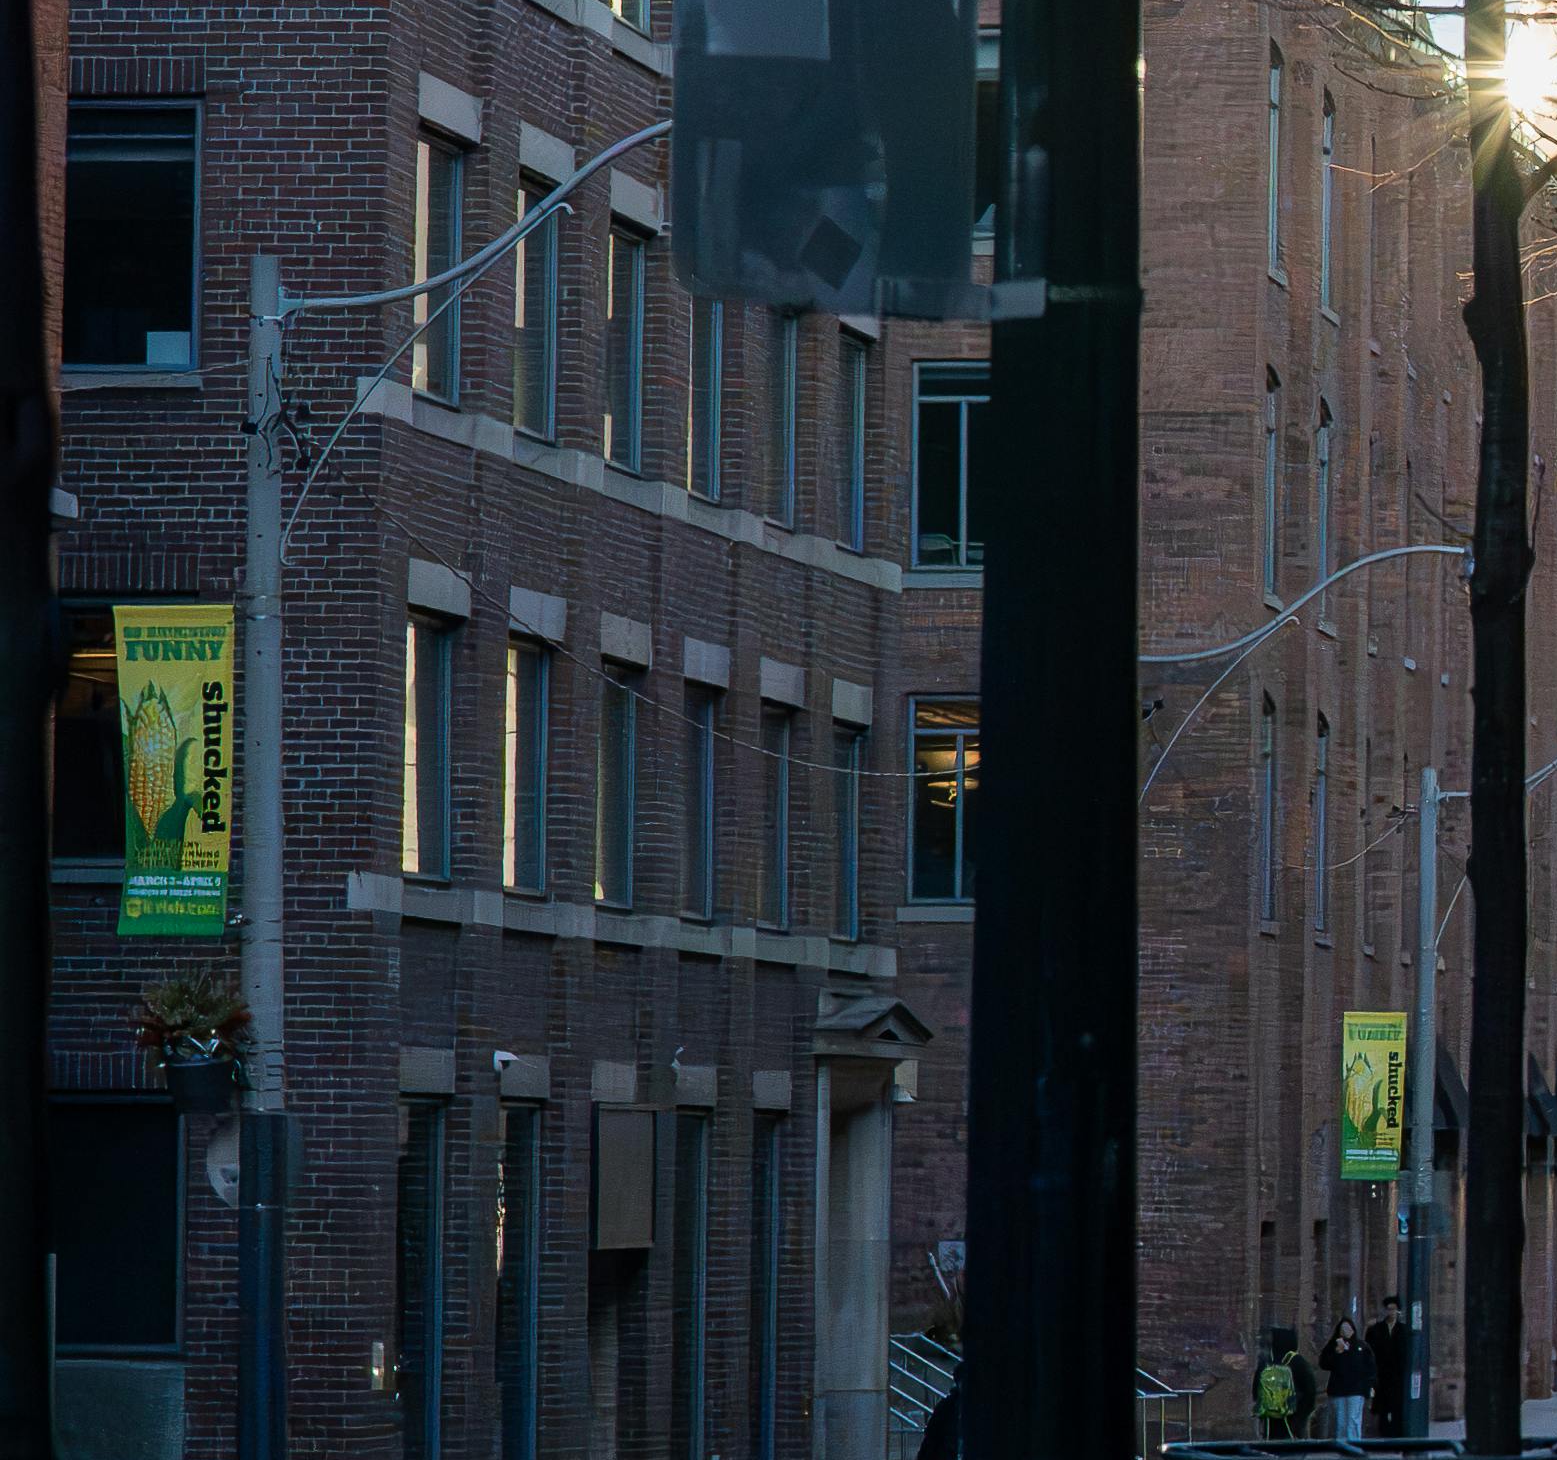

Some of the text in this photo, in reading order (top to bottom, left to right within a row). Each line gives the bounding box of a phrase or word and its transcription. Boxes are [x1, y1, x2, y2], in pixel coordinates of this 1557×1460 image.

[124, 640, 225, 661] FUNNY
[202, 681, 228, 834] shucked
[1386, 1051, 1402, 1129] shucked
